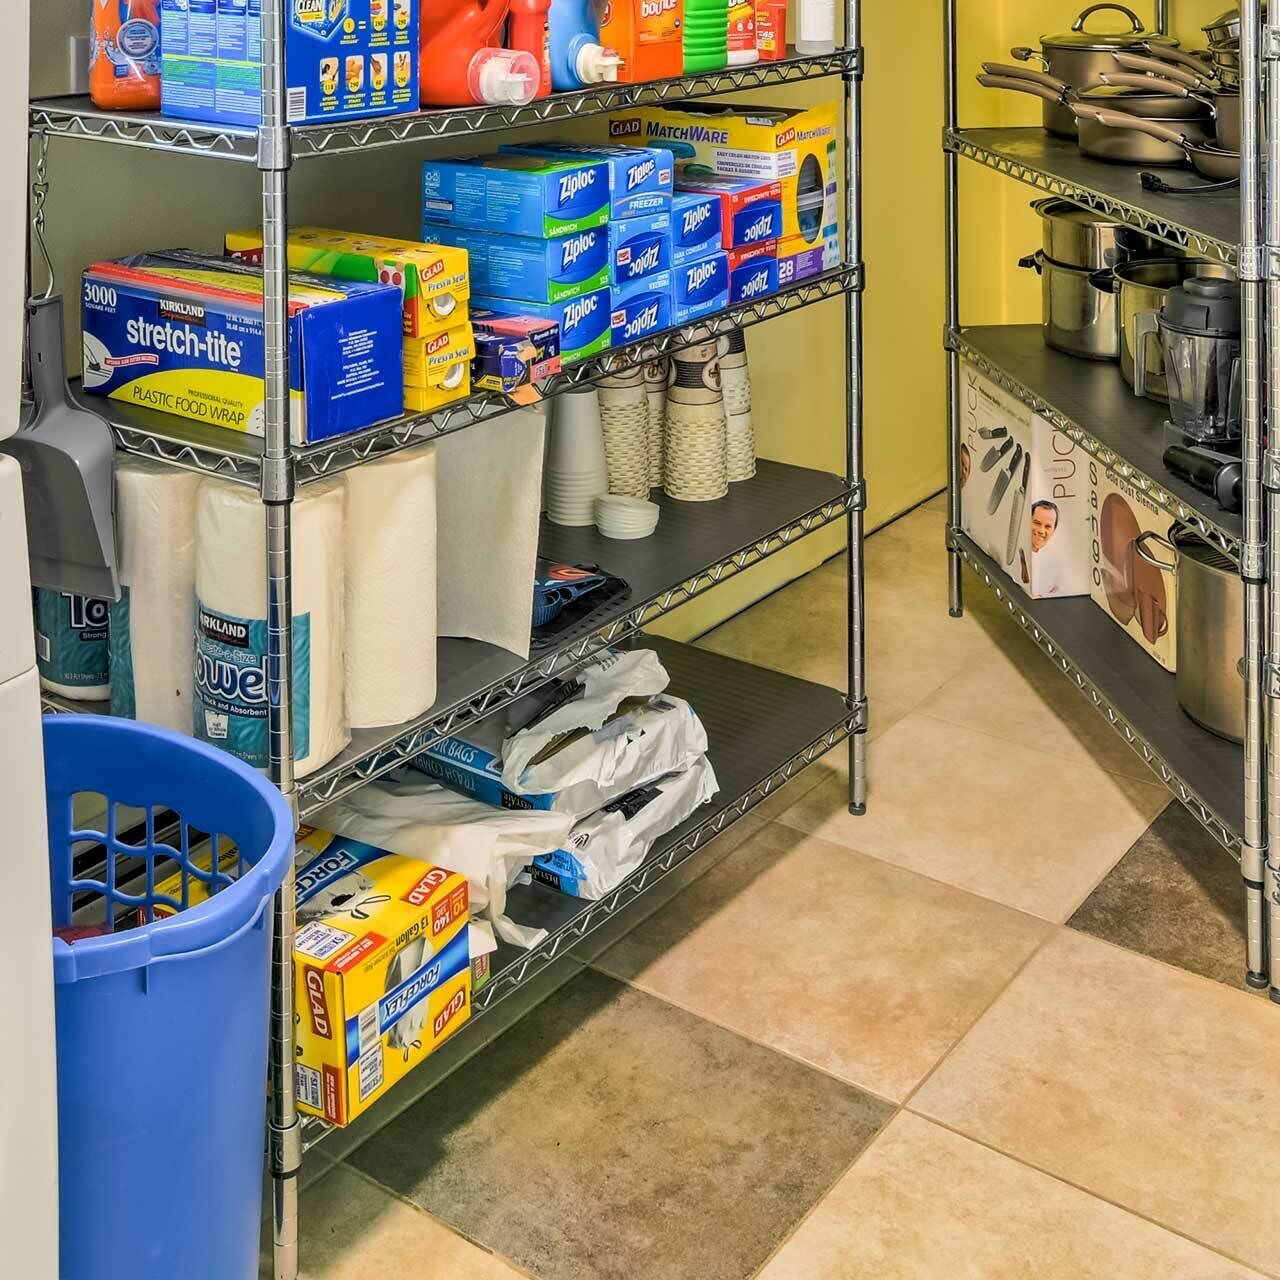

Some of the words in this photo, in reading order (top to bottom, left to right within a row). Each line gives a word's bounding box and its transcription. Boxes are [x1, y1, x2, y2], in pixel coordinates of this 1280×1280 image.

[611, 121, 640, 134] GLAD
[777, 130, 794, 146] GLAD
[560, 170, 595, 200] Ziploc
[628, 159, 655, 189] Ziploc
[630, 198, 663, 209] FREEZER
[683, 204, 711, 233] Ziploc
[744, 215, 772, 241] Ziploc
[562, 232, 595, 265] Ziploc
[630, 244, 659, 276] Ziploc
[422, 261, 443, 280] GLAD
[688, 261, 717, 290] Ziploc
[742, 270, 768, 298] Ziploc
[779, 262, 793, 278] 28
[84, 283, 117, 306] 3000
[85, 302, 103, 311] SQUARE
[160, 299, 204, 317] KIRKLAND
[564, 296, 597, 330] Ziploc
[625, 304, 658, 338] Ziploc
[127, 317, 241, 367] stretch-tite
[427, 334, 449, 353] GLAD
[133, 386, 173, 409] PLASTIC
[175, 399, 207, 416] FOOD
[209, 407, 244, 424] WRAP
[188, 389, 220, 402] PROFESSIONAL
[222, 398, 243, 408] QUALITY
[969, 377, 977, 452] PUCK
[1136, 492, 1159, 516] Sienna
[231, 707, 267, 717] Absorbent
[448, 740, 479, 762] BAGS
[410, 869, 447, 904] GLAD
[306, 970, 329, 1035] GLAD
[384, 962, 440, 1016] FORCEFLEX
[435, 987, 466, 1034] GLAD
